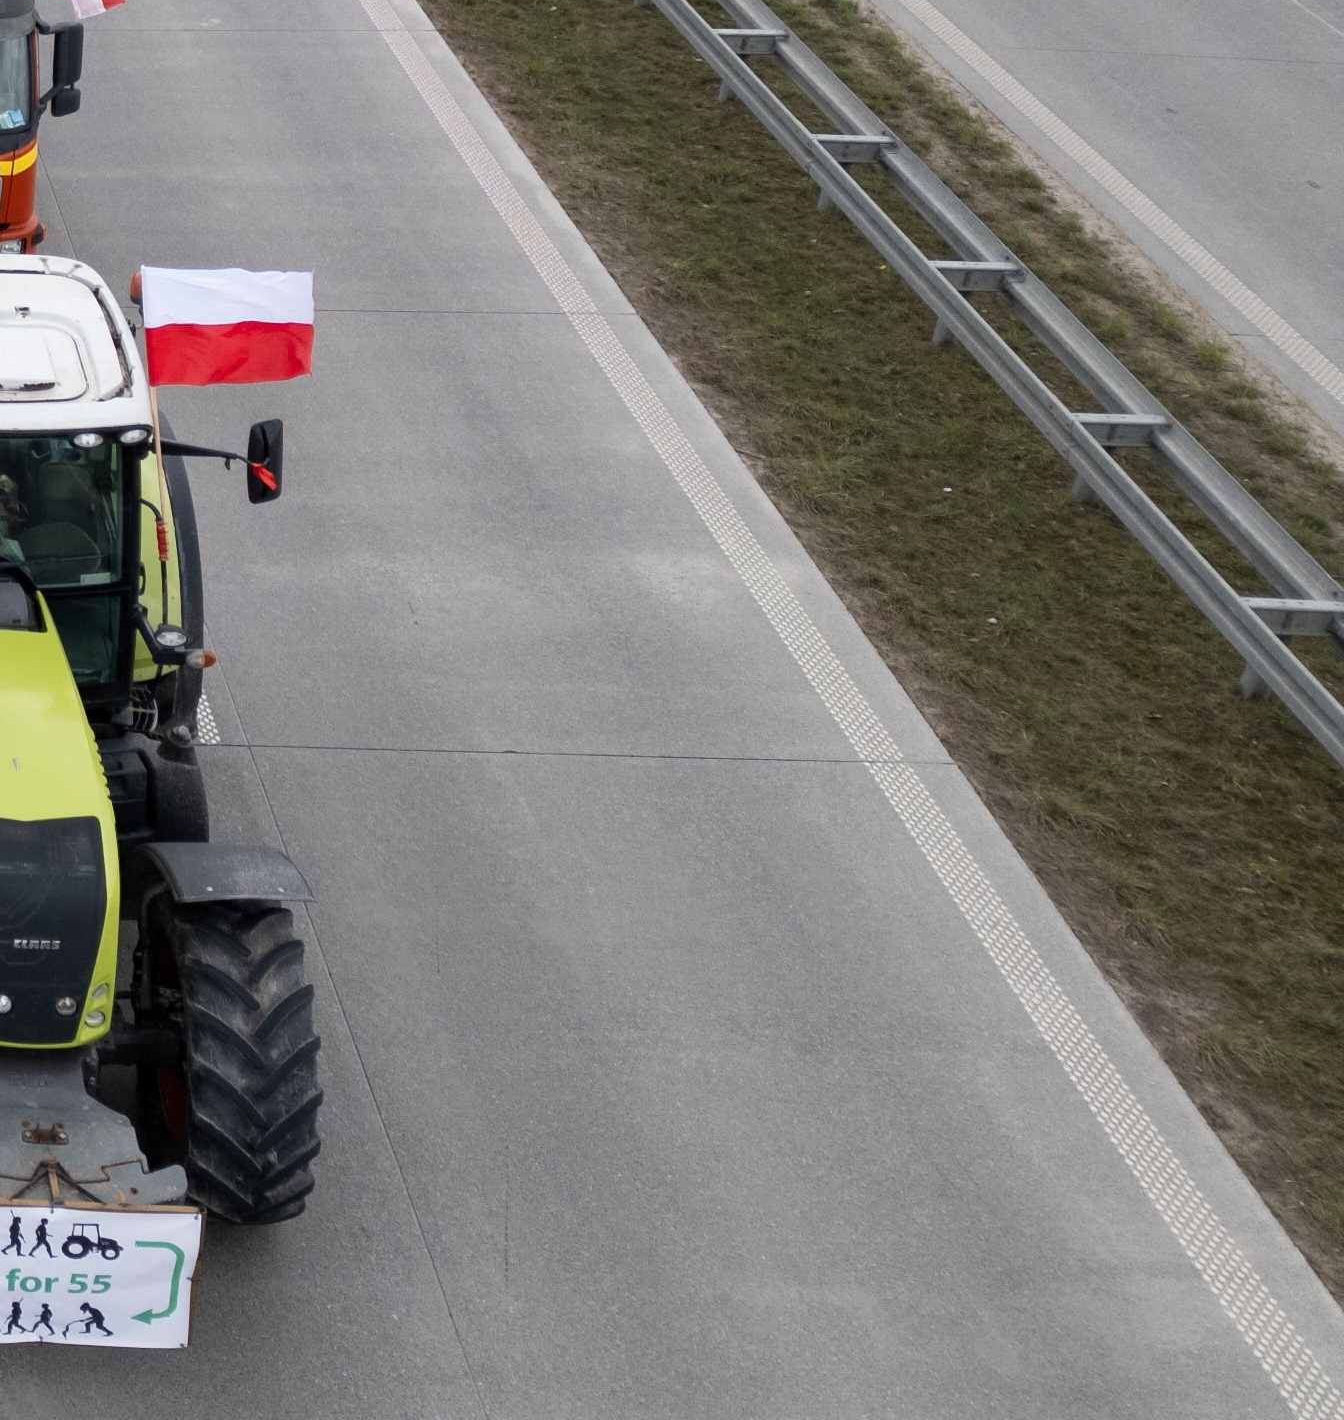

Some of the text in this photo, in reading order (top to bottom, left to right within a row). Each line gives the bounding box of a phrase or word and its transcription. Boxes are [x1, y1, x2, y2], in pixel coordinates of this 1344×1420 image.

[13, 939, 61, 950] CLAAS
[5, 1268, 59, 1293] for
[67, 1273, 112, 1294] 55
